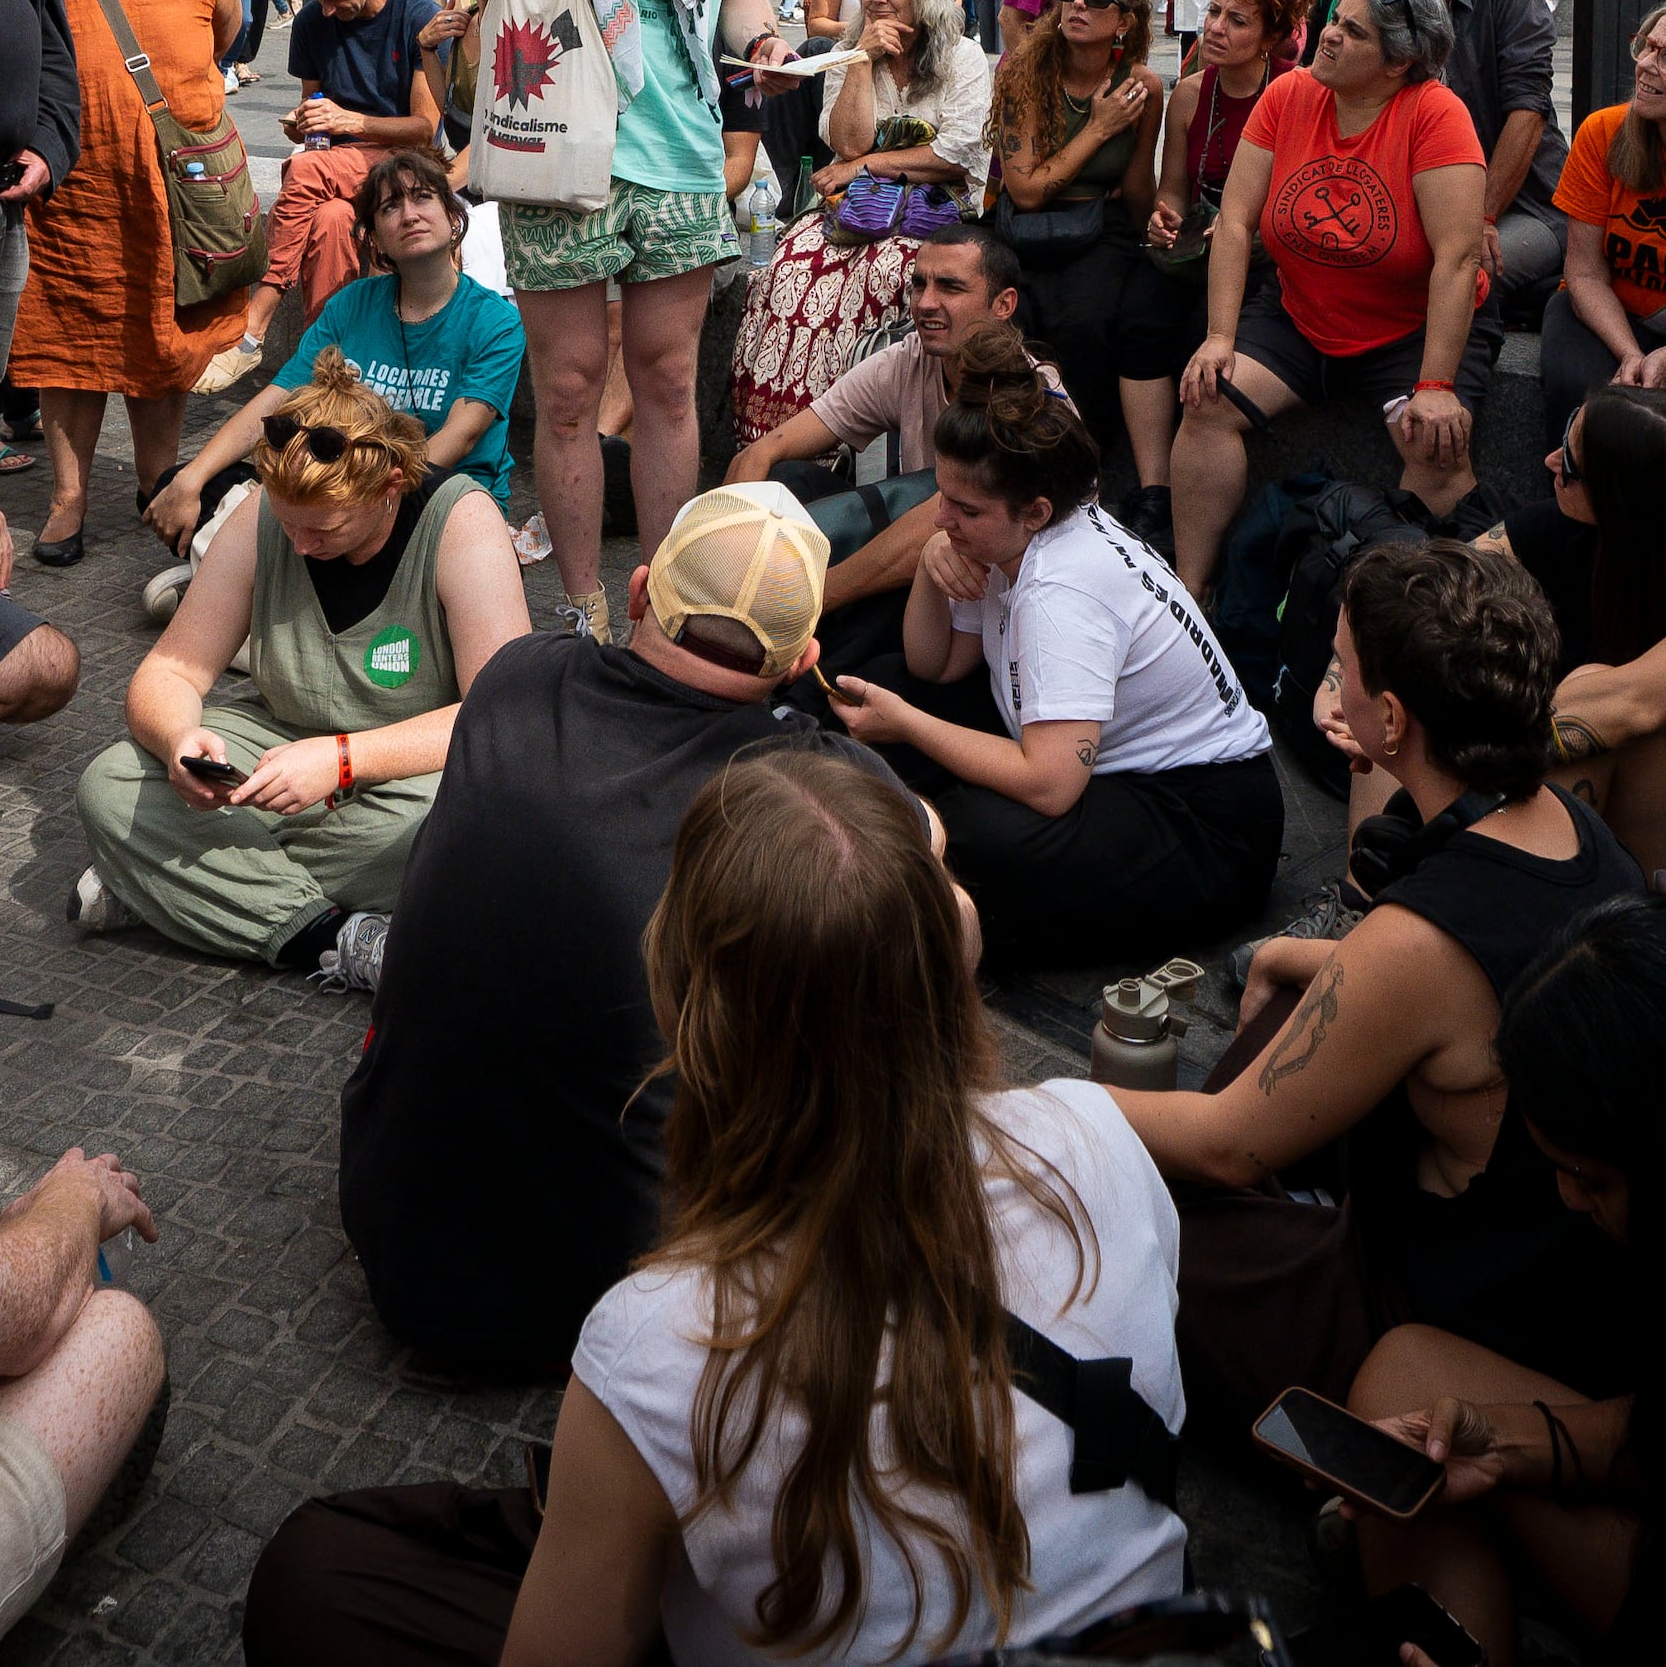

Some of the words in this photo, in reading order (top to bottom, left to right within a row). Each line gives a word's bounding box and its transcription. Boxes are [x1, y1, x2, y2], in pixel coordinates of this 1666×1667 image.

[1278, 164, 1327, 216] SINDICAT
[1328, 160, 1343, 174] DE
[1345, 161, 1390, 233] LLOGATERES
[1283, 231, 1312, 256] ENS
[1318, 244, 1381, 265] QUEDEM
[1141, 570, 1170, 604] ES
[371, 653, 410, 664] RENTERS
[372, 637, 410, 654] LONDON
[1169, 603, 1234, 704] MADRID
[370, 661, 410, 673] UNION
